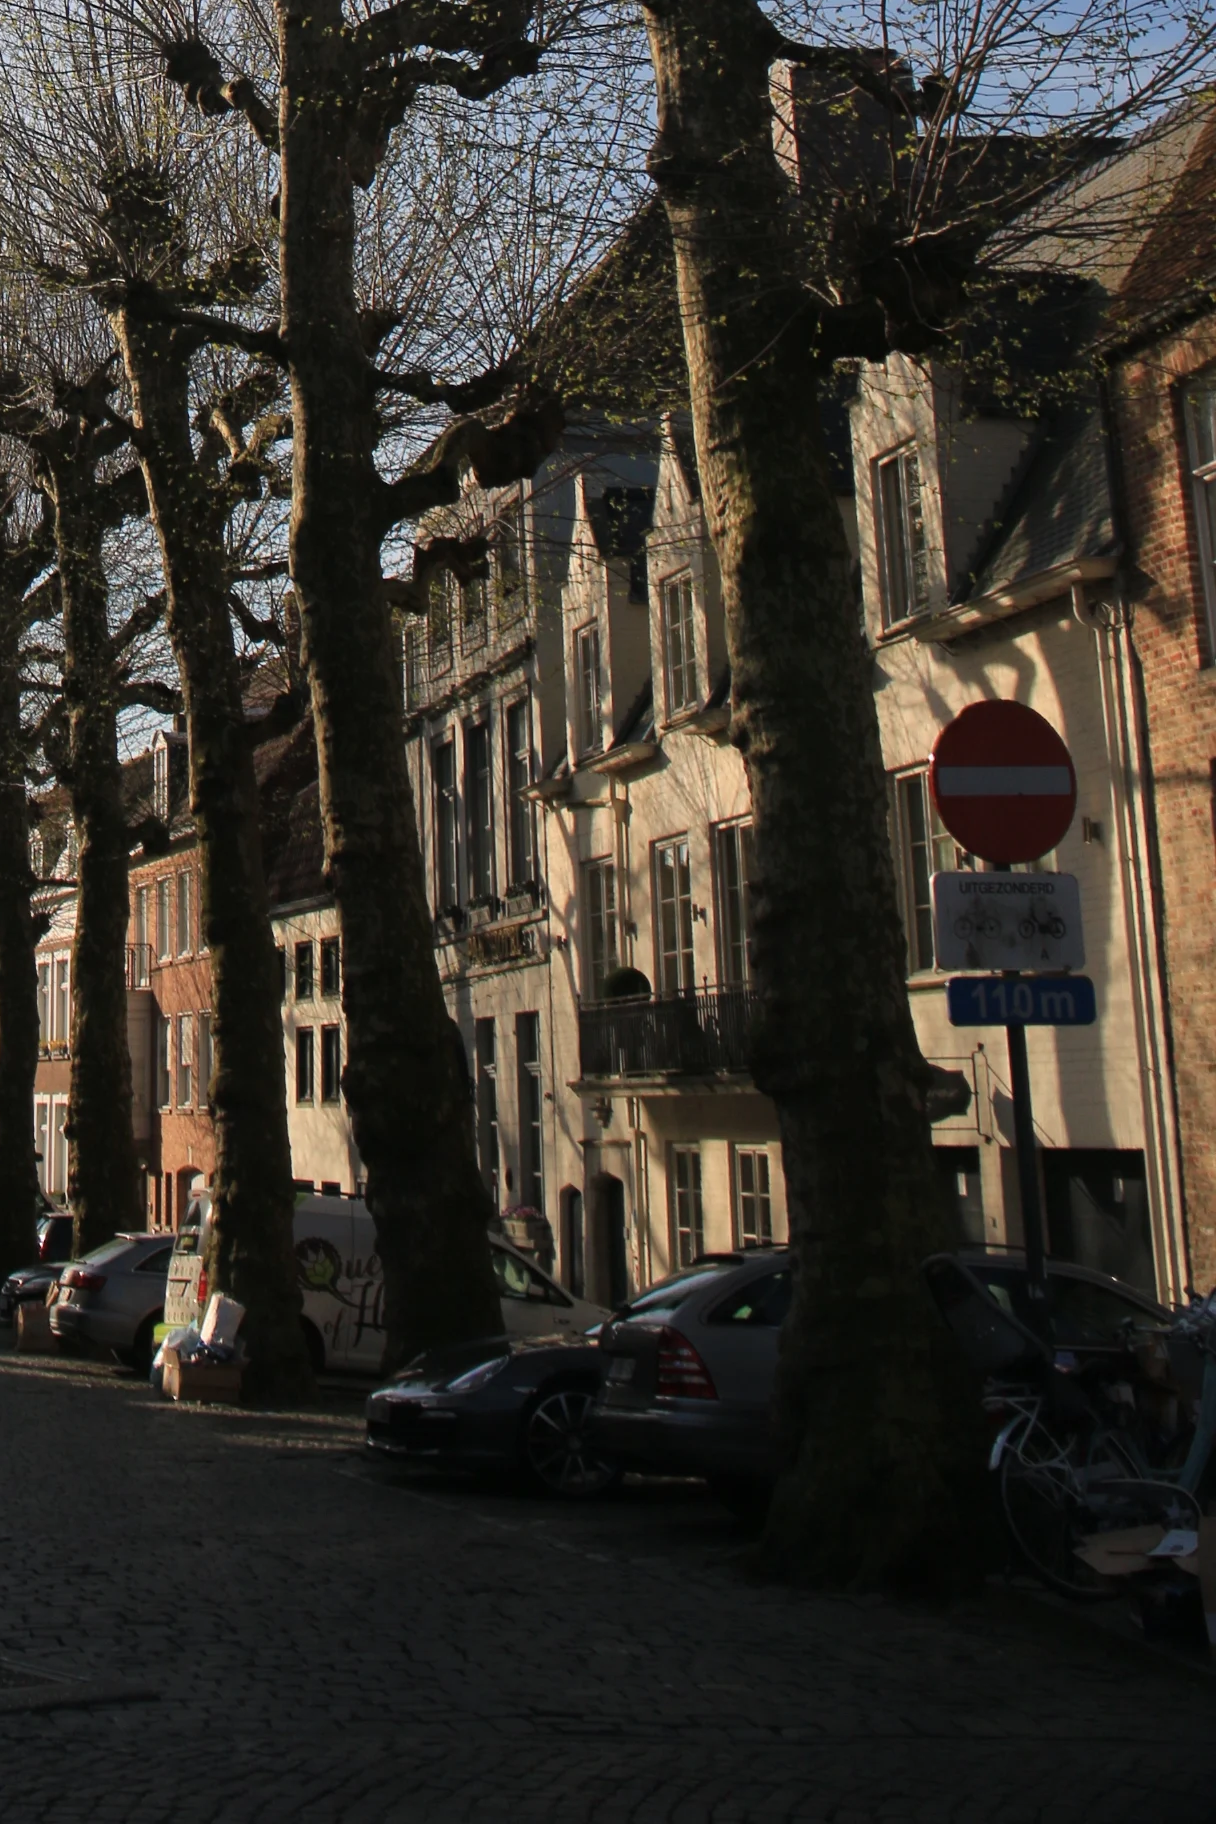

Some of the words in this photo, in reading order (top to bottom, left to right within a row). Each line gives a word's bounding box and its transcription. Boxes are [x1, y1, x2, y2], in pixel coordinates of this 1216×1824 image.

[959, 881, 1055, 895] UITGEZONDERD
[1041, 948, 1049, 961] A
[971, 983, 1033, 1020] 110
[1040, 990, 1076, 1020] m
